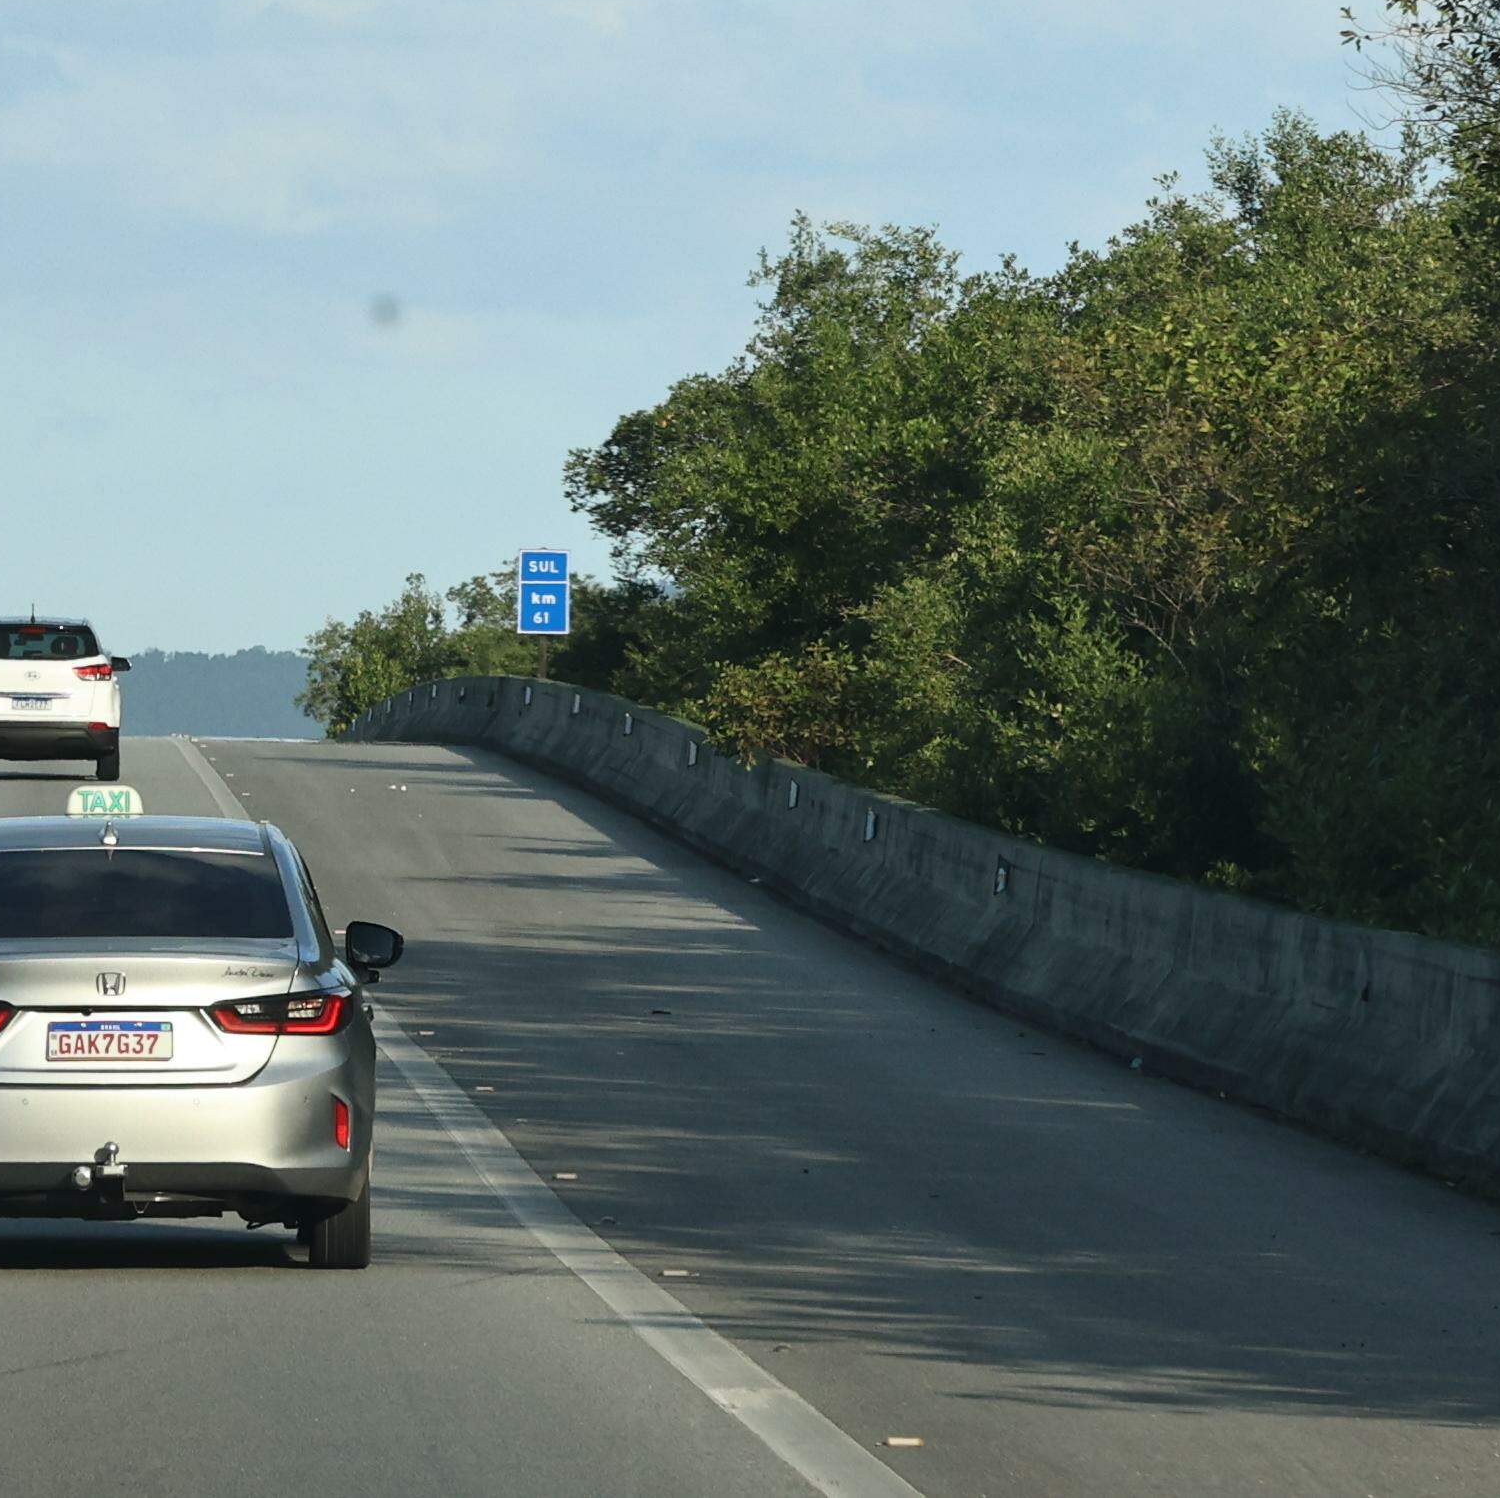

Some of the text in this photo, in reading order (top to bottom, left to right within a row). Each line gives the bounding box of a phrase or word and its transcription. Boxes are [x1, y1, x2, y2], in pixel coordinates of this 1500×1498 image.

[529, 560, 559, 573] SUL
[531, 592, 556, 604] km
[533, 612, 549, 624] 61
[77, 790, 130, 812] TAXI
[59, 1034, 158, 1054] GAK7G37
